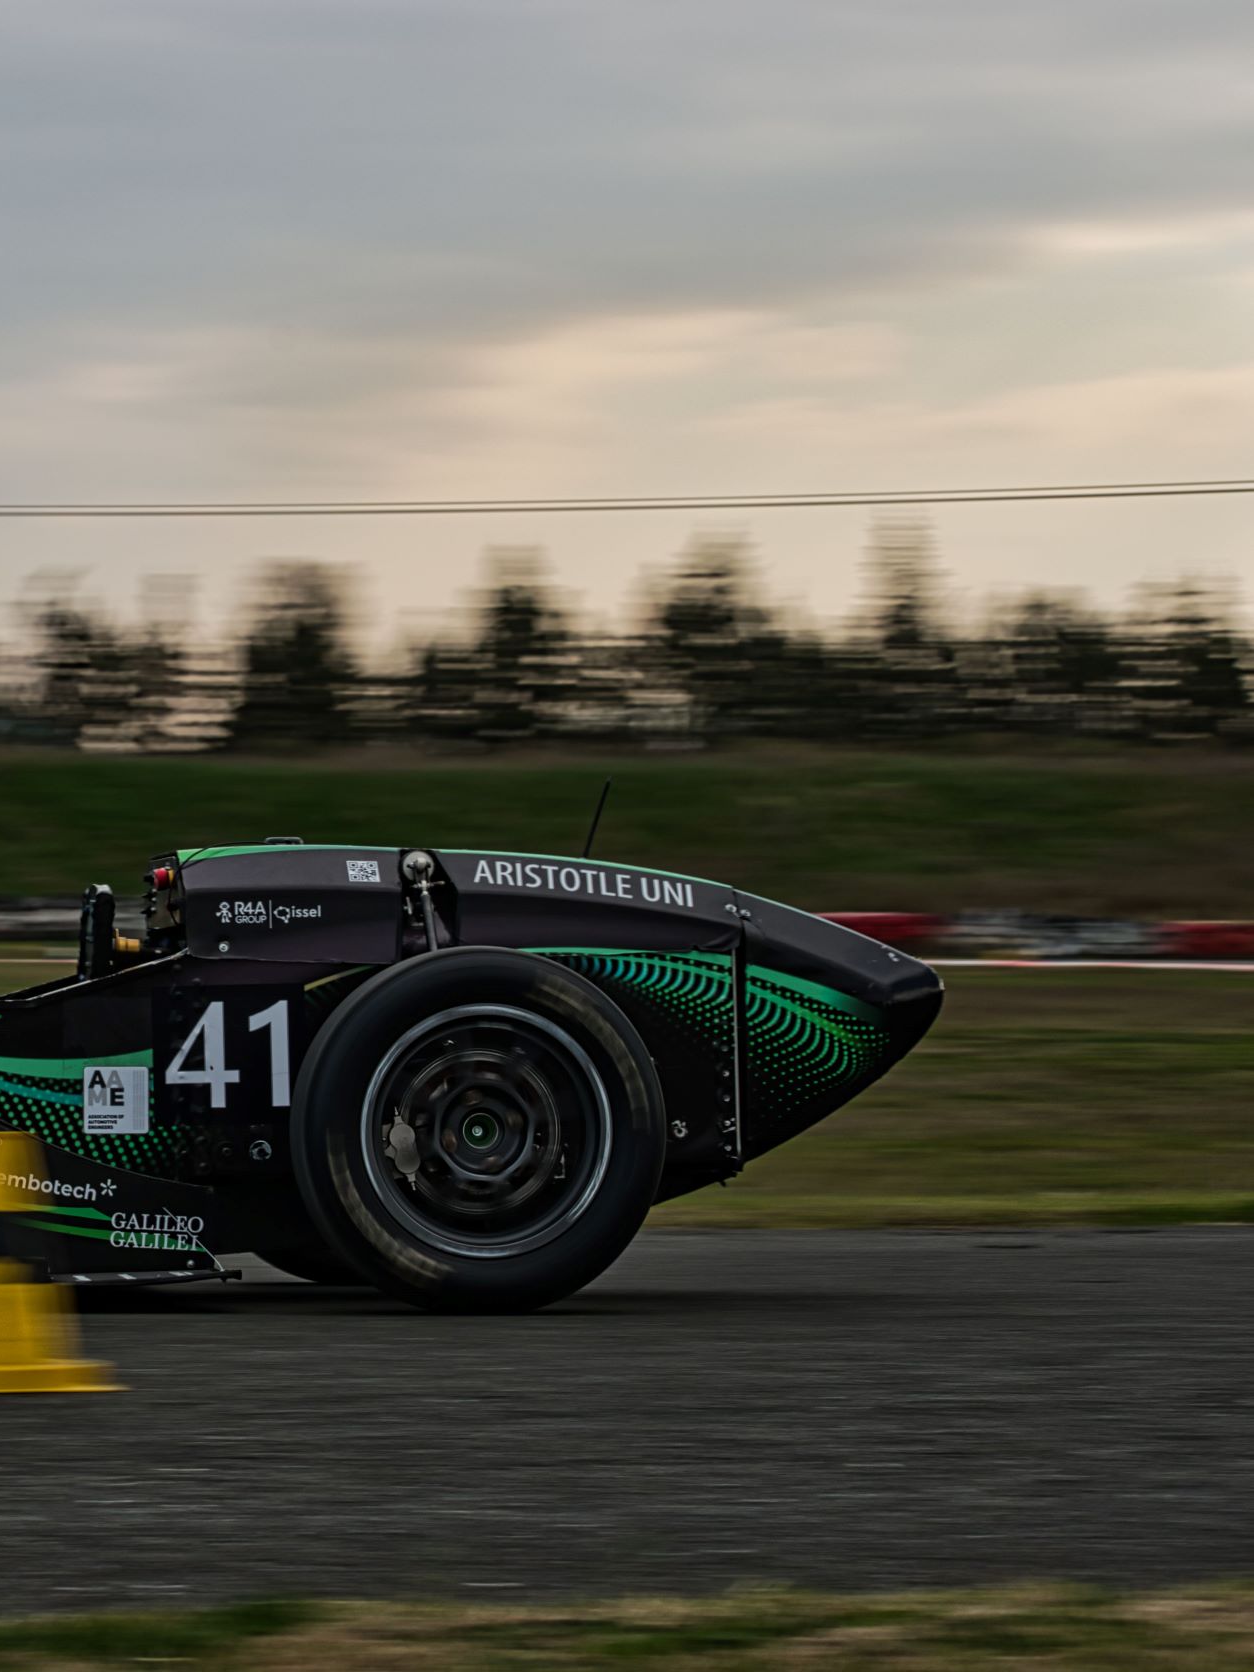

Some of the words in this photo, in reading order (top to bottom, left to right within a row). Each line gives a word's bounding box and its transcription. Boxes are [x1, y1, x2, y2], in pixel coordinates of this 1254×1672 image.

[474, 860, 633, 899] ARISTOTLE
[640, 877, 694, 907] UNI
[234, 901, 266, 915] R4A
[291, 904, 321, 918] issel
[235, 915, 267, 924] GROUP
[165, 1000, 291, 1108] 41
[110, 1212, 204, 1233] GALILEO
[109, 1230, 199, 1251] GALILEI
